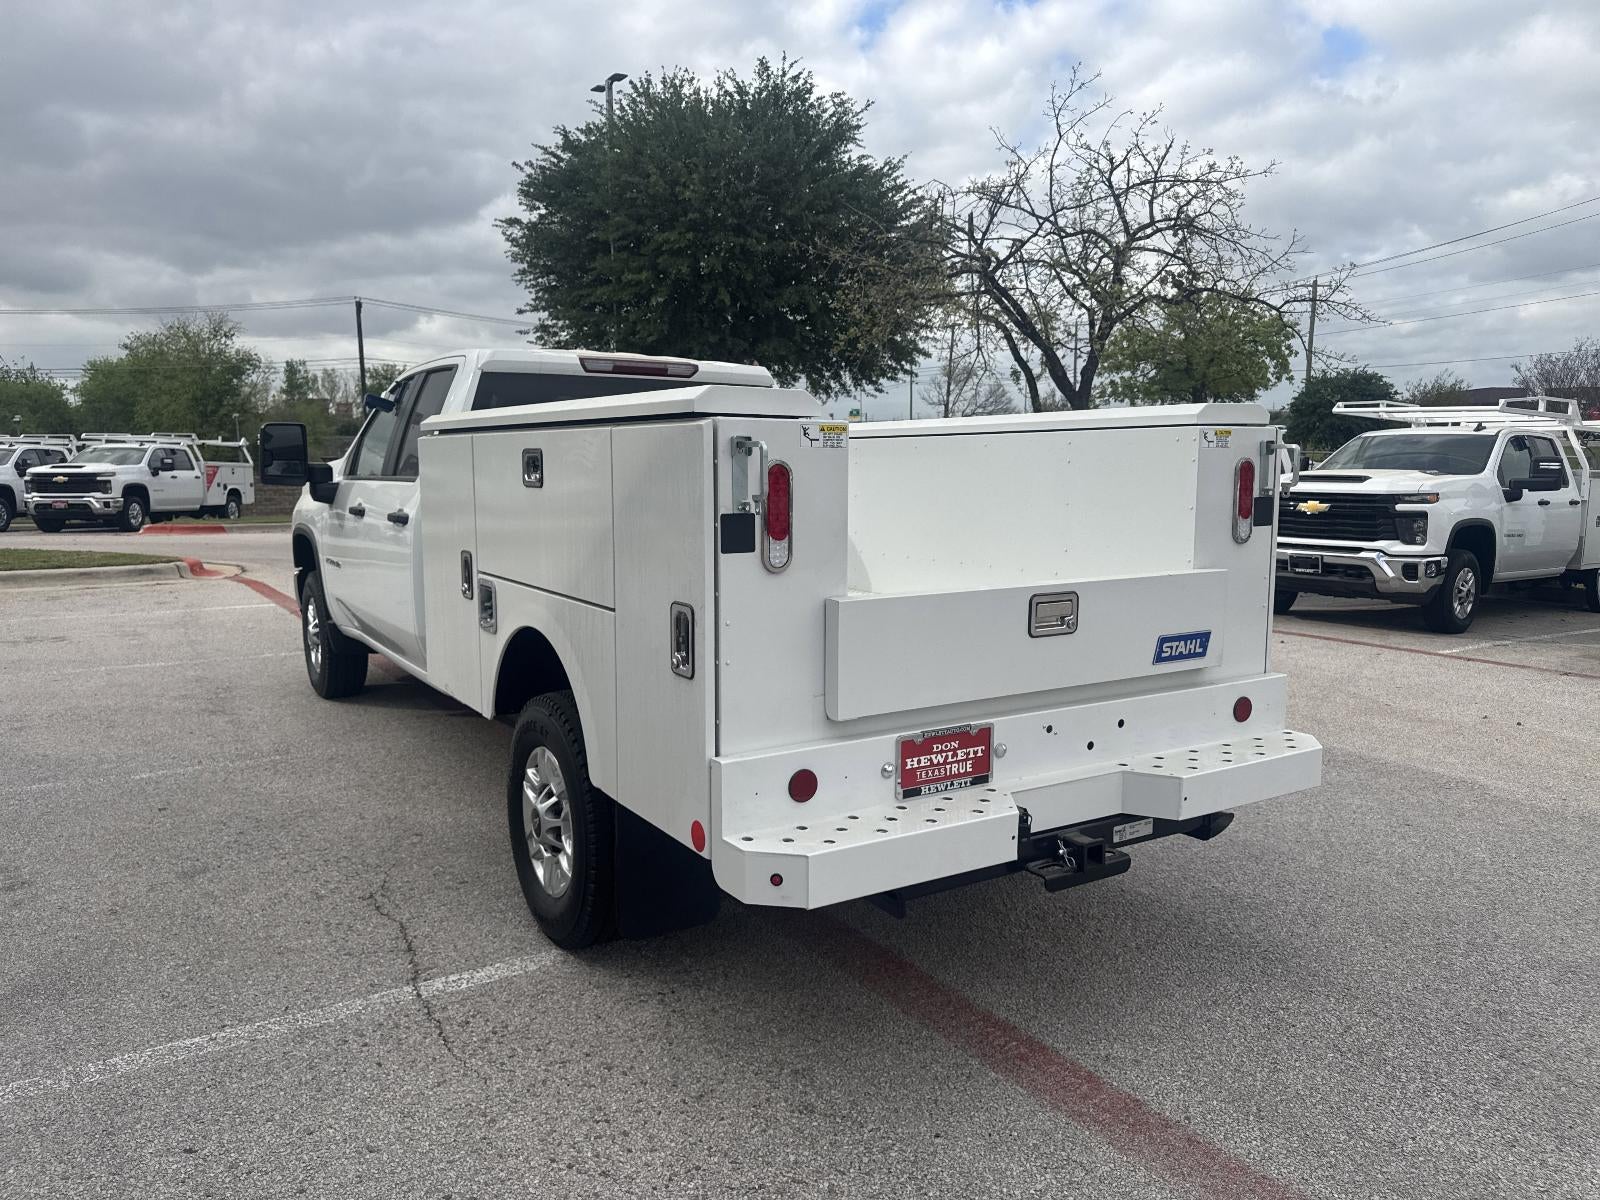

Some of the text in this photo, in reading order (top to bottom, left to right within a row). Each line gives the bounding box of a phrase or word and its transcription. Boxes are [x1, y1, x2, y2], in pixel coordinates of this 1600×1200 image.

[1161, 638, 1203, 657] STAHL
[932, 740, 960, 752] DON
[905, 746, 985, 769] HEWLETT
[921, 778, 973, 795] HEWLETT
